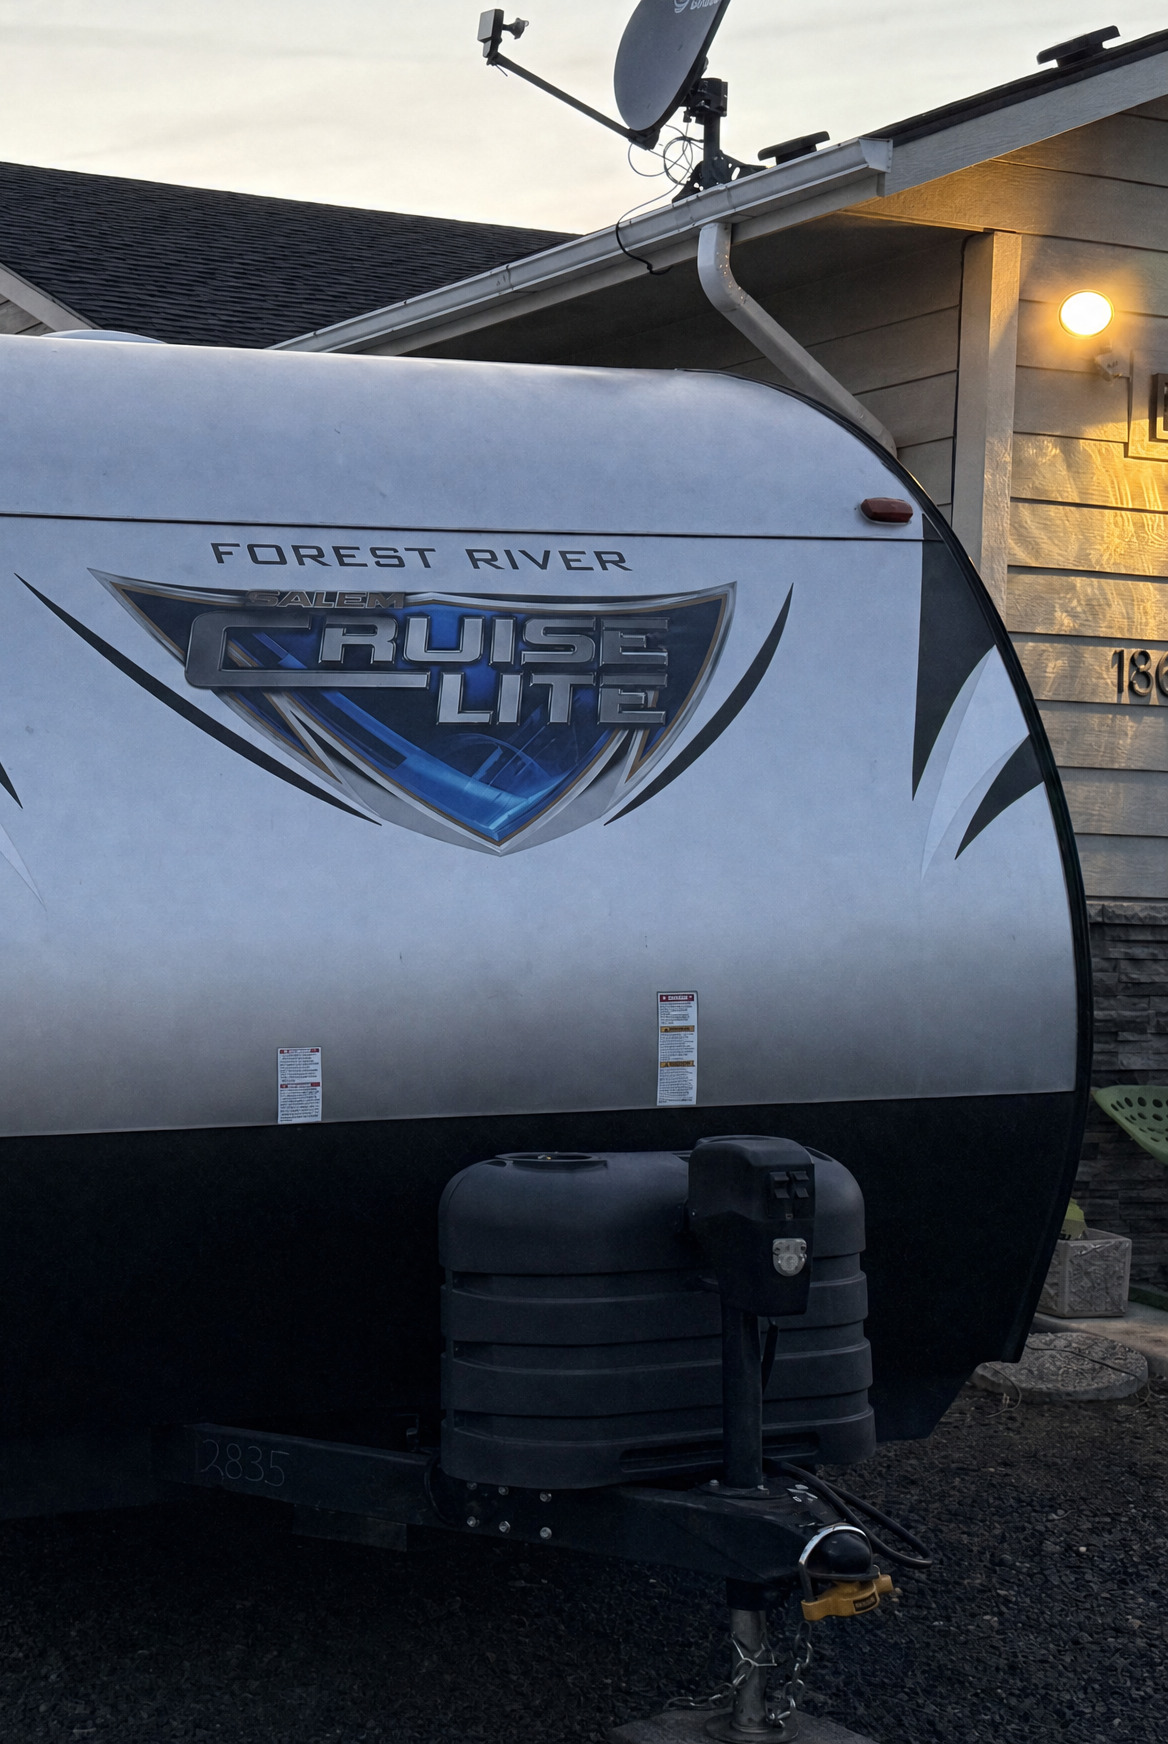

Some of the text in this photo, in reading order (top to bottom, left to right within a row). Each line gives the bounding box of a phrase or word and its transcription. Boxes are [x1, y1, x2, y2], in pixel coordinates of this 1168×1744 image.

[210, 542, 634, 572] FOREST RIVER
[244, 588, 407, 609] SALEM
[185, 610, 669, 690] CRUISE
[436, 671, 668, 725] LITE
[199, 1438, 290, 1487] 2835
